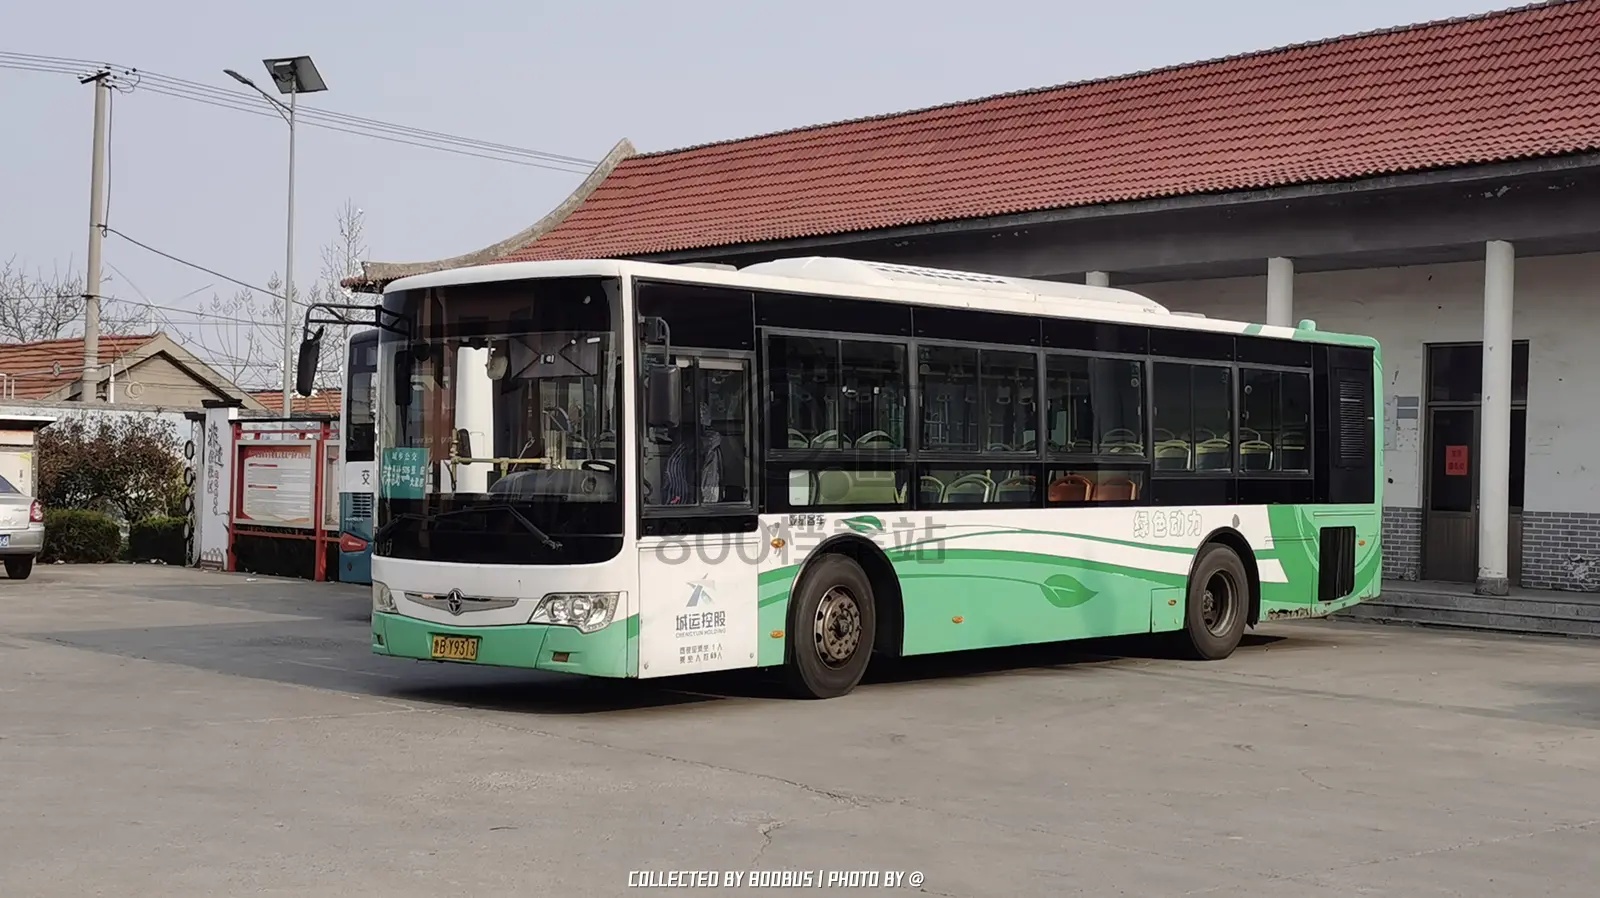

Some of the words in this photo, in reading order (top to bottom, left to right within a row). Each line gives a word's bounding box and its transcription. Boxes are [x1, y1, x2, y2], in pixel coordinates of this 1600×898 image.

[1133, 509, 1203, 539] 绿色动力
[675, 610, 726, 631] 城运控股
[675, 630, 704, 638] CHENGYUN
[704, 628, 726, 636] HOLDING
